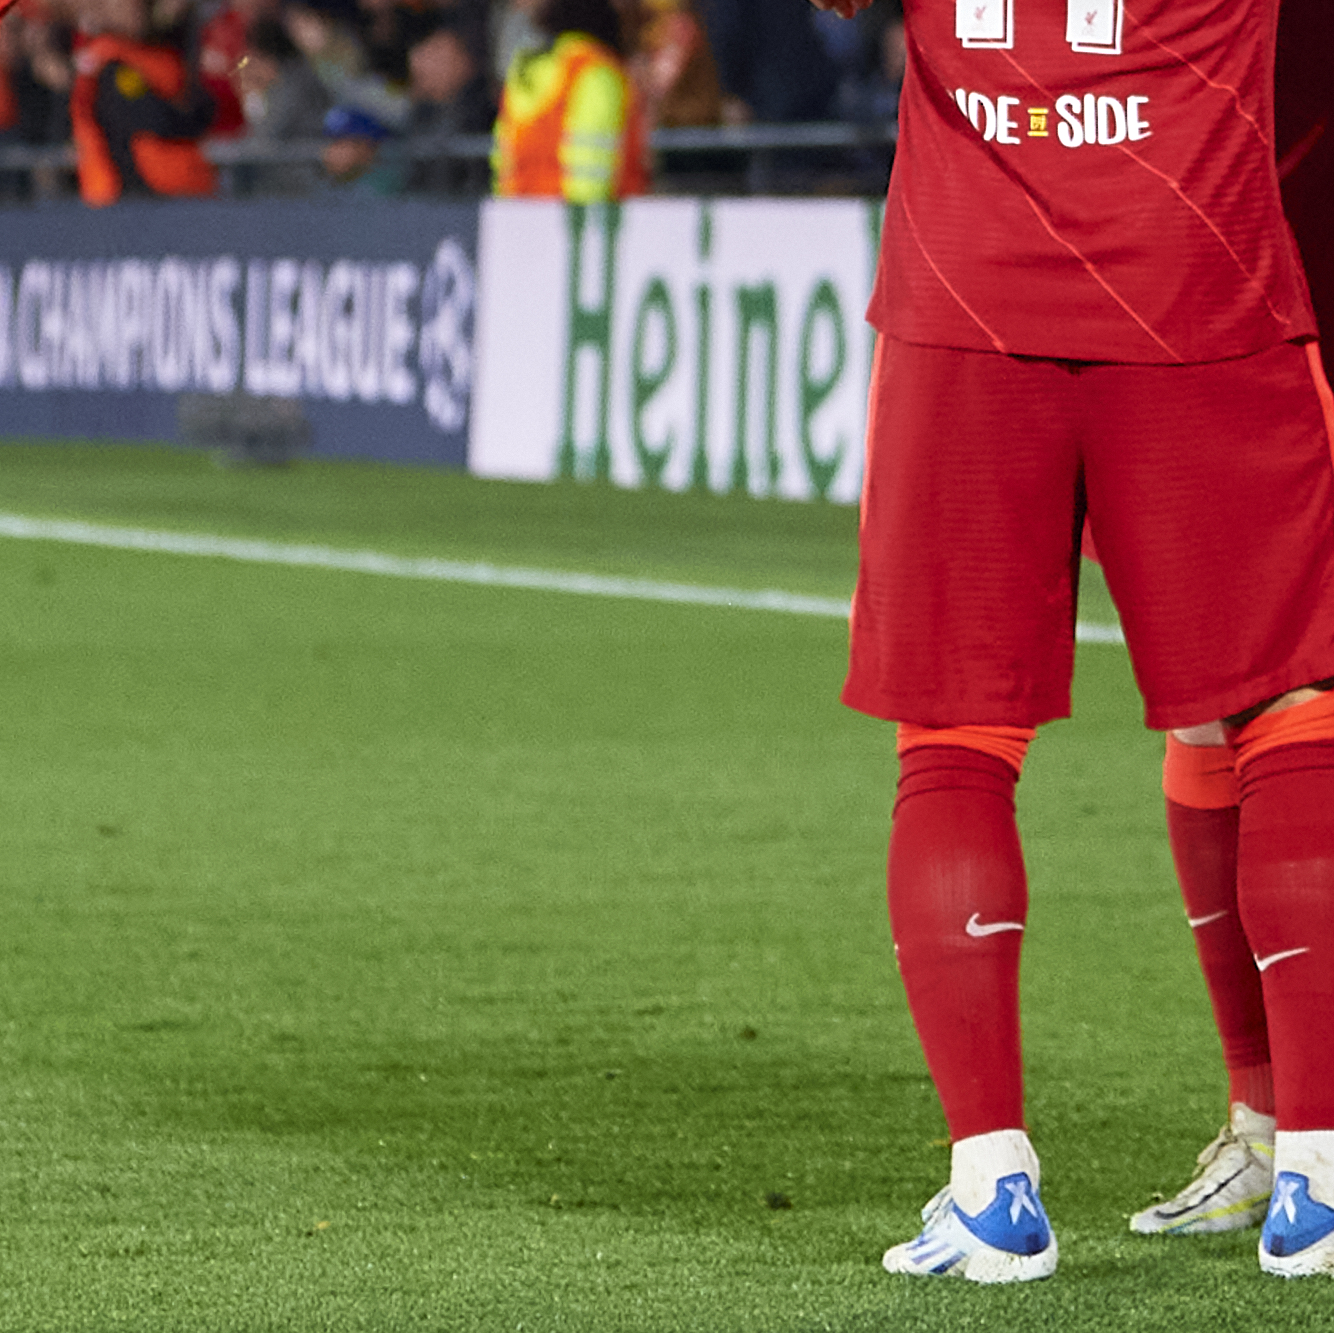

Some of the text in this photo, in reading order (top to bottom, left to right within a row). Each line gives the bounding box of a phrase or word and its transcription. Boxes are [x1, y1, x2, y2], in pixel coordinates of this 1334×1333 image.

[953, 88, 1021, 145] IDE
[1055, 93, 1153, 148] SIDE
[15, 257, 240, 394] CHAMPIONS
[244, 257, 419, 404] LEAGUE
[557, 202, 881, 496] Heine
